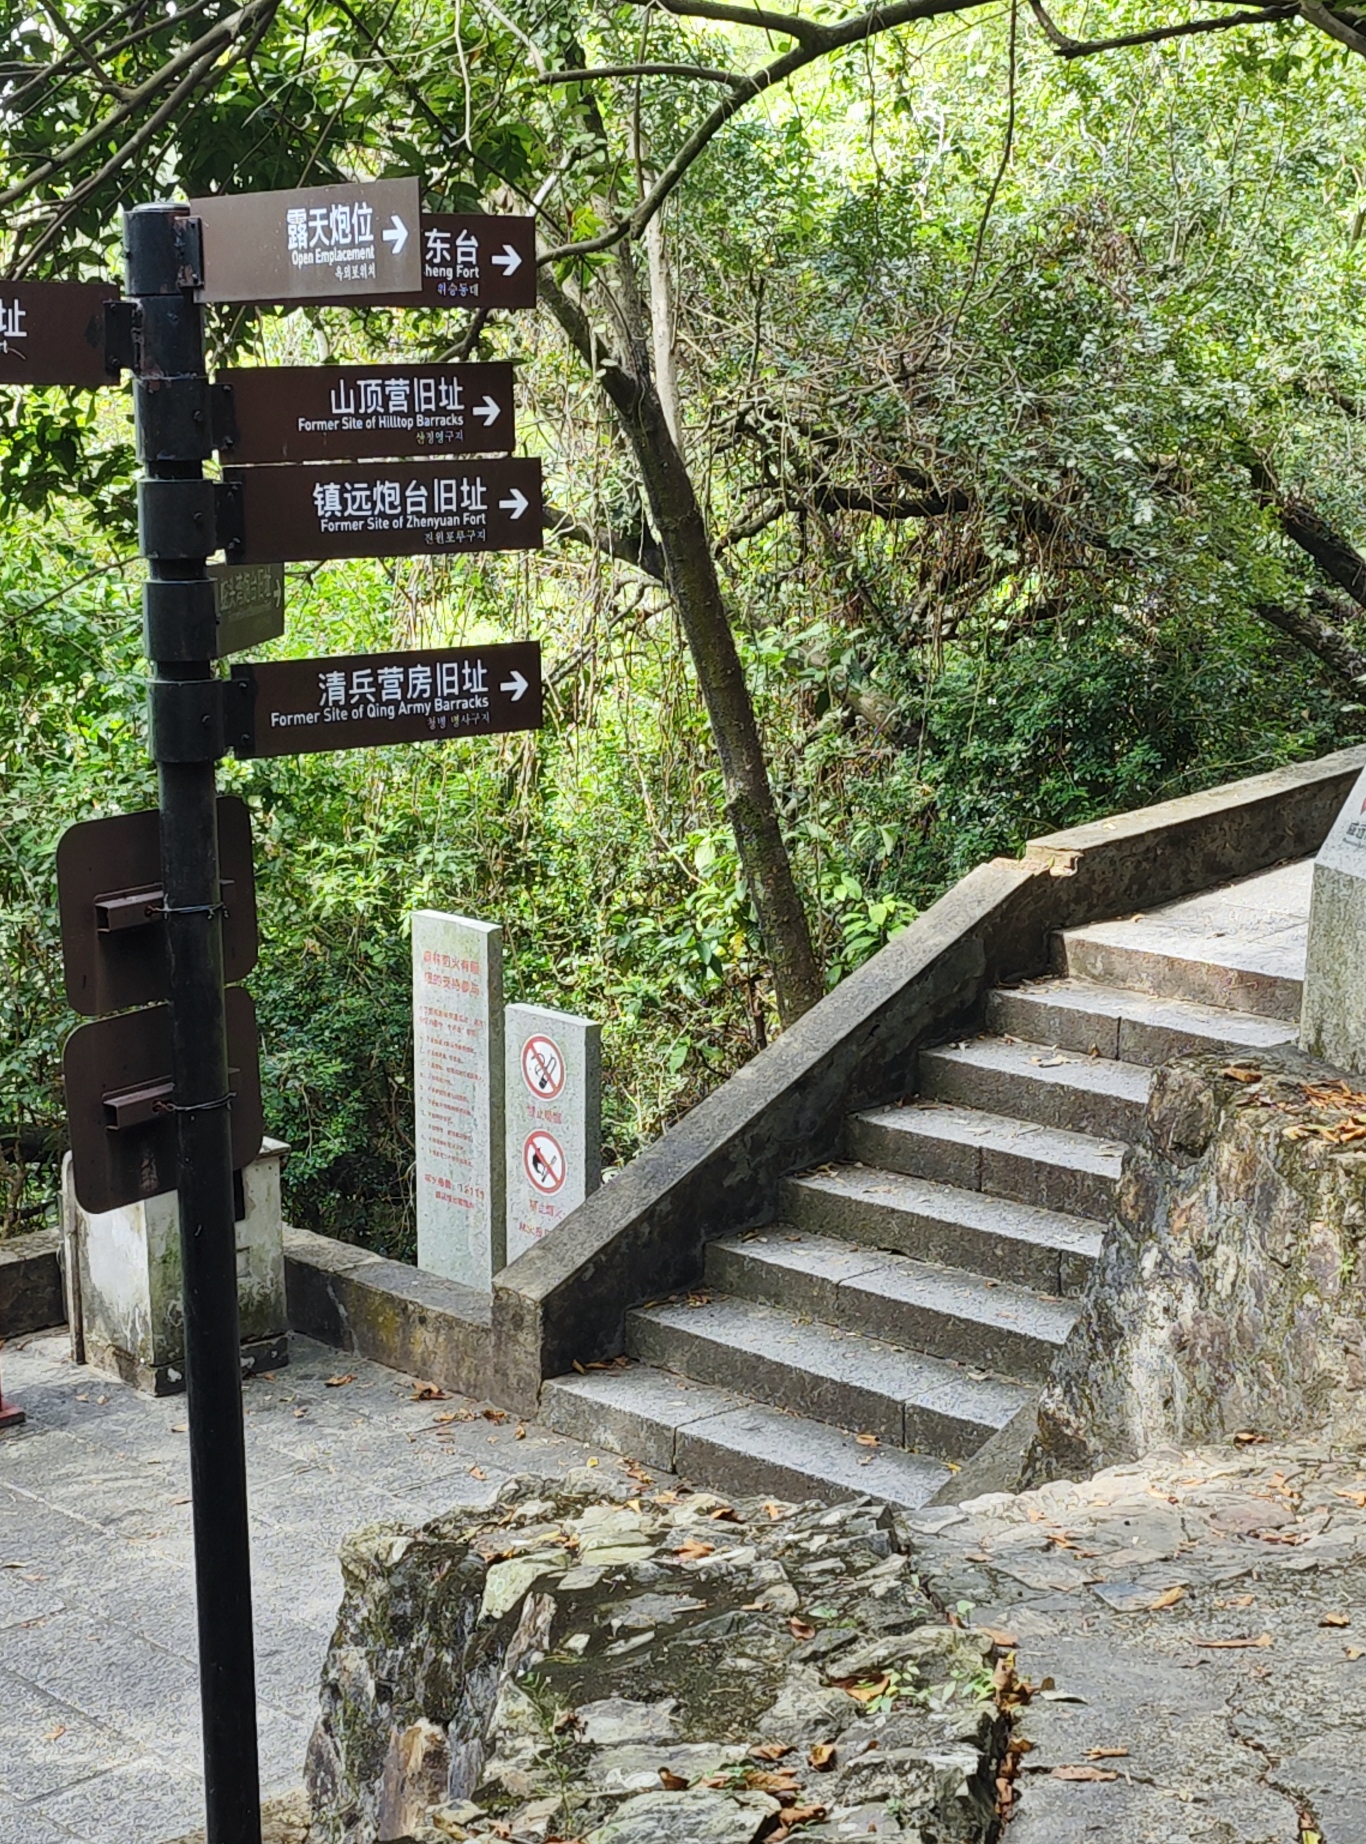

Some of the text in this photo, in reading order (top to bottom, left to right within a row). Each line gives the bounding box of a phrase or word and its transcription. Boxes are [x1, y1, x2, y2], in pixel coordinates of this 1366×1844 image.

[287, 202, 374, 250] 露天炮位
[292, 245, 375, 269] Open Emplacement
[425, 228, 479, 264] 东台
[424, 264, 480, 280] heng Fort
[330, 376, 465, 415] 山顶营旧址
[298, 413, 464, 431] Former Site of Hilltop Barracks
[312, 476, 488, 517] 镇远炮台旧址
[320, 513, 487, 533] Former Site of Zhenyuan Fort
[318, 659, 489, 706] 清兵营房旧址
[270, 695, 489, 727] Former Site of Qing Army Barracks
